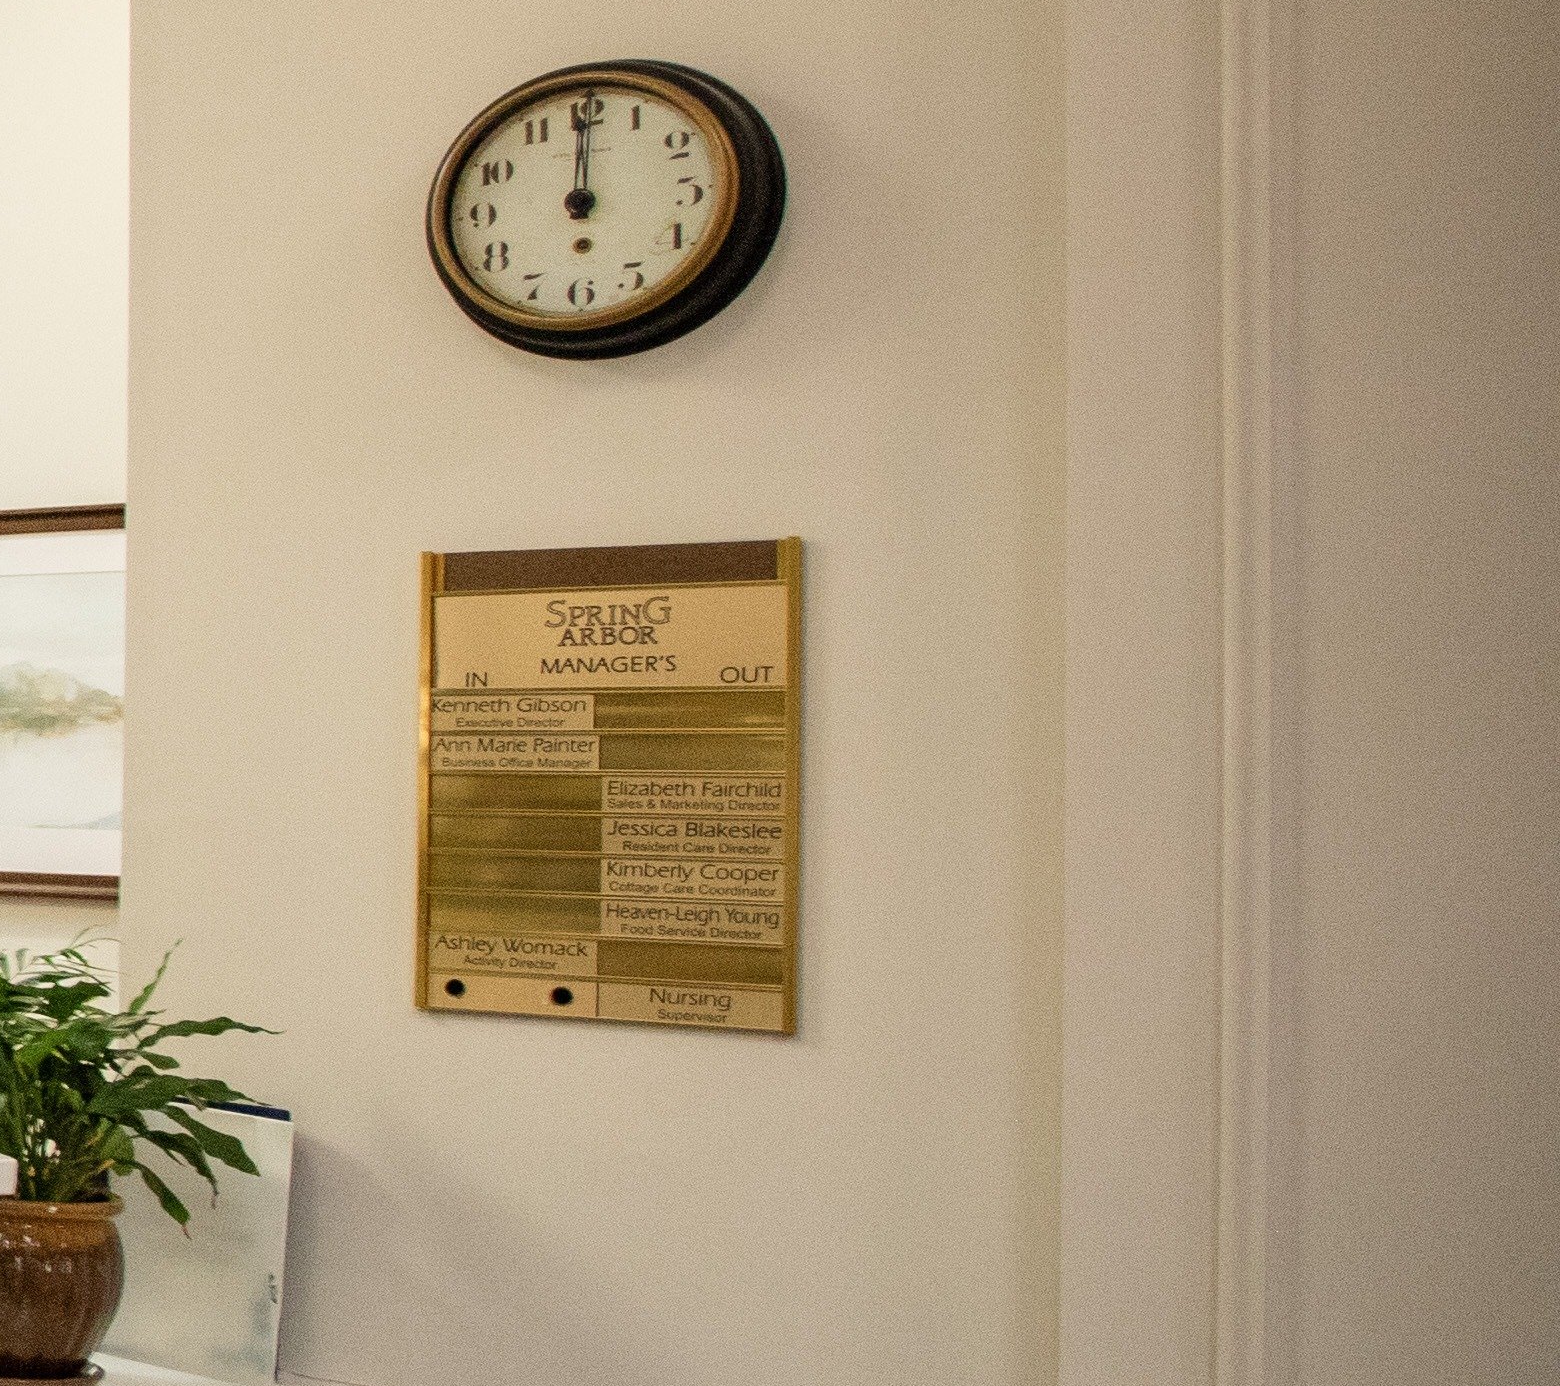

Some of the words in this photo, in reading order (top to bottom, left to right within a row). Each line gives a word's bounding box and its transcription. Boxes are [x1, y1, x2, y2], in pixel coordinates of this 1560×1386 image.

[570, 98, 604, 132] 12
[631, 105, 640, 131] 1
[524, 117, 548, 146] 11
[664, 131, 690, 161] 2
[482, 158, 514, 186] 10
[676, 176, 703, 206] 3
[470, 203, 497, 228] 9
[655, 222, 688, 251] 4
[483, 241, 509, 273] 8
[524, 272, 545, 301] 7
[618, 262, 645, 291] 5
[567, 278, 594, 307] 6
[545, 596, 672, 628] SPRING
[558, 625, 658, 647] ARBOR
[540, 655, 676, 674] MANAGER'S
[720, 665, 774, 684] OUT
[465, 671, 488, 687] IN
[432, 698, 510, 713] Kenneth
[517, 698, 587, 713] Gibson
[455, 717, 513, 729] Executive
[517, 717, 565, 729] Director
[435, 738, 471, 752] Ann
[476, 738, 526, 752] Marie
[533, 739, 593, 753] Painter
[442, 757, 495, 768] Business
[499, 757, 533, 768] Office
[537, 757, 592, 771] Manager
[607, 780, 695, 796] Elizabeth
[702, 782, 781, 798] Fairchild
[608, 798, 643, 809] Sales
[647, 799, 655, 809] &
[659, 800, 724, 812] Marketing
[728, 800, 781, 811] Director
[607, 821, 678, 837] Jessica
[685, 822, 782, 839] Blakeslee
[622, 841, 679, 853] Resident
[683, 843, 715, 853] Care
[719, 843, 771, 855] Director
[606, 862, 695, 882] Kimberly
[700, 864, 779, 885] Cooper
[609, 881, 658, 895] Cottage
[662, 883, 694, 895] Care
[698, 885, 776, 897] Coordinator
[606, 903, 720, 926] Heaven-Leigh
[724, 908, 780, 929] Young
[621, 924, 653, 935] Food
[658, 925, 705, 937] Service
[710, 928, 762, 940] Director
[435, 935, 498, 955] Ashley
[502, 938, 588, 957] Womack
[464, 955, 505, 969] Activity
[509, 957, 556, 970] Director
[649, 988, 731, 1011] Nursing
[657, 1008, 727, 1023] Supervisor
